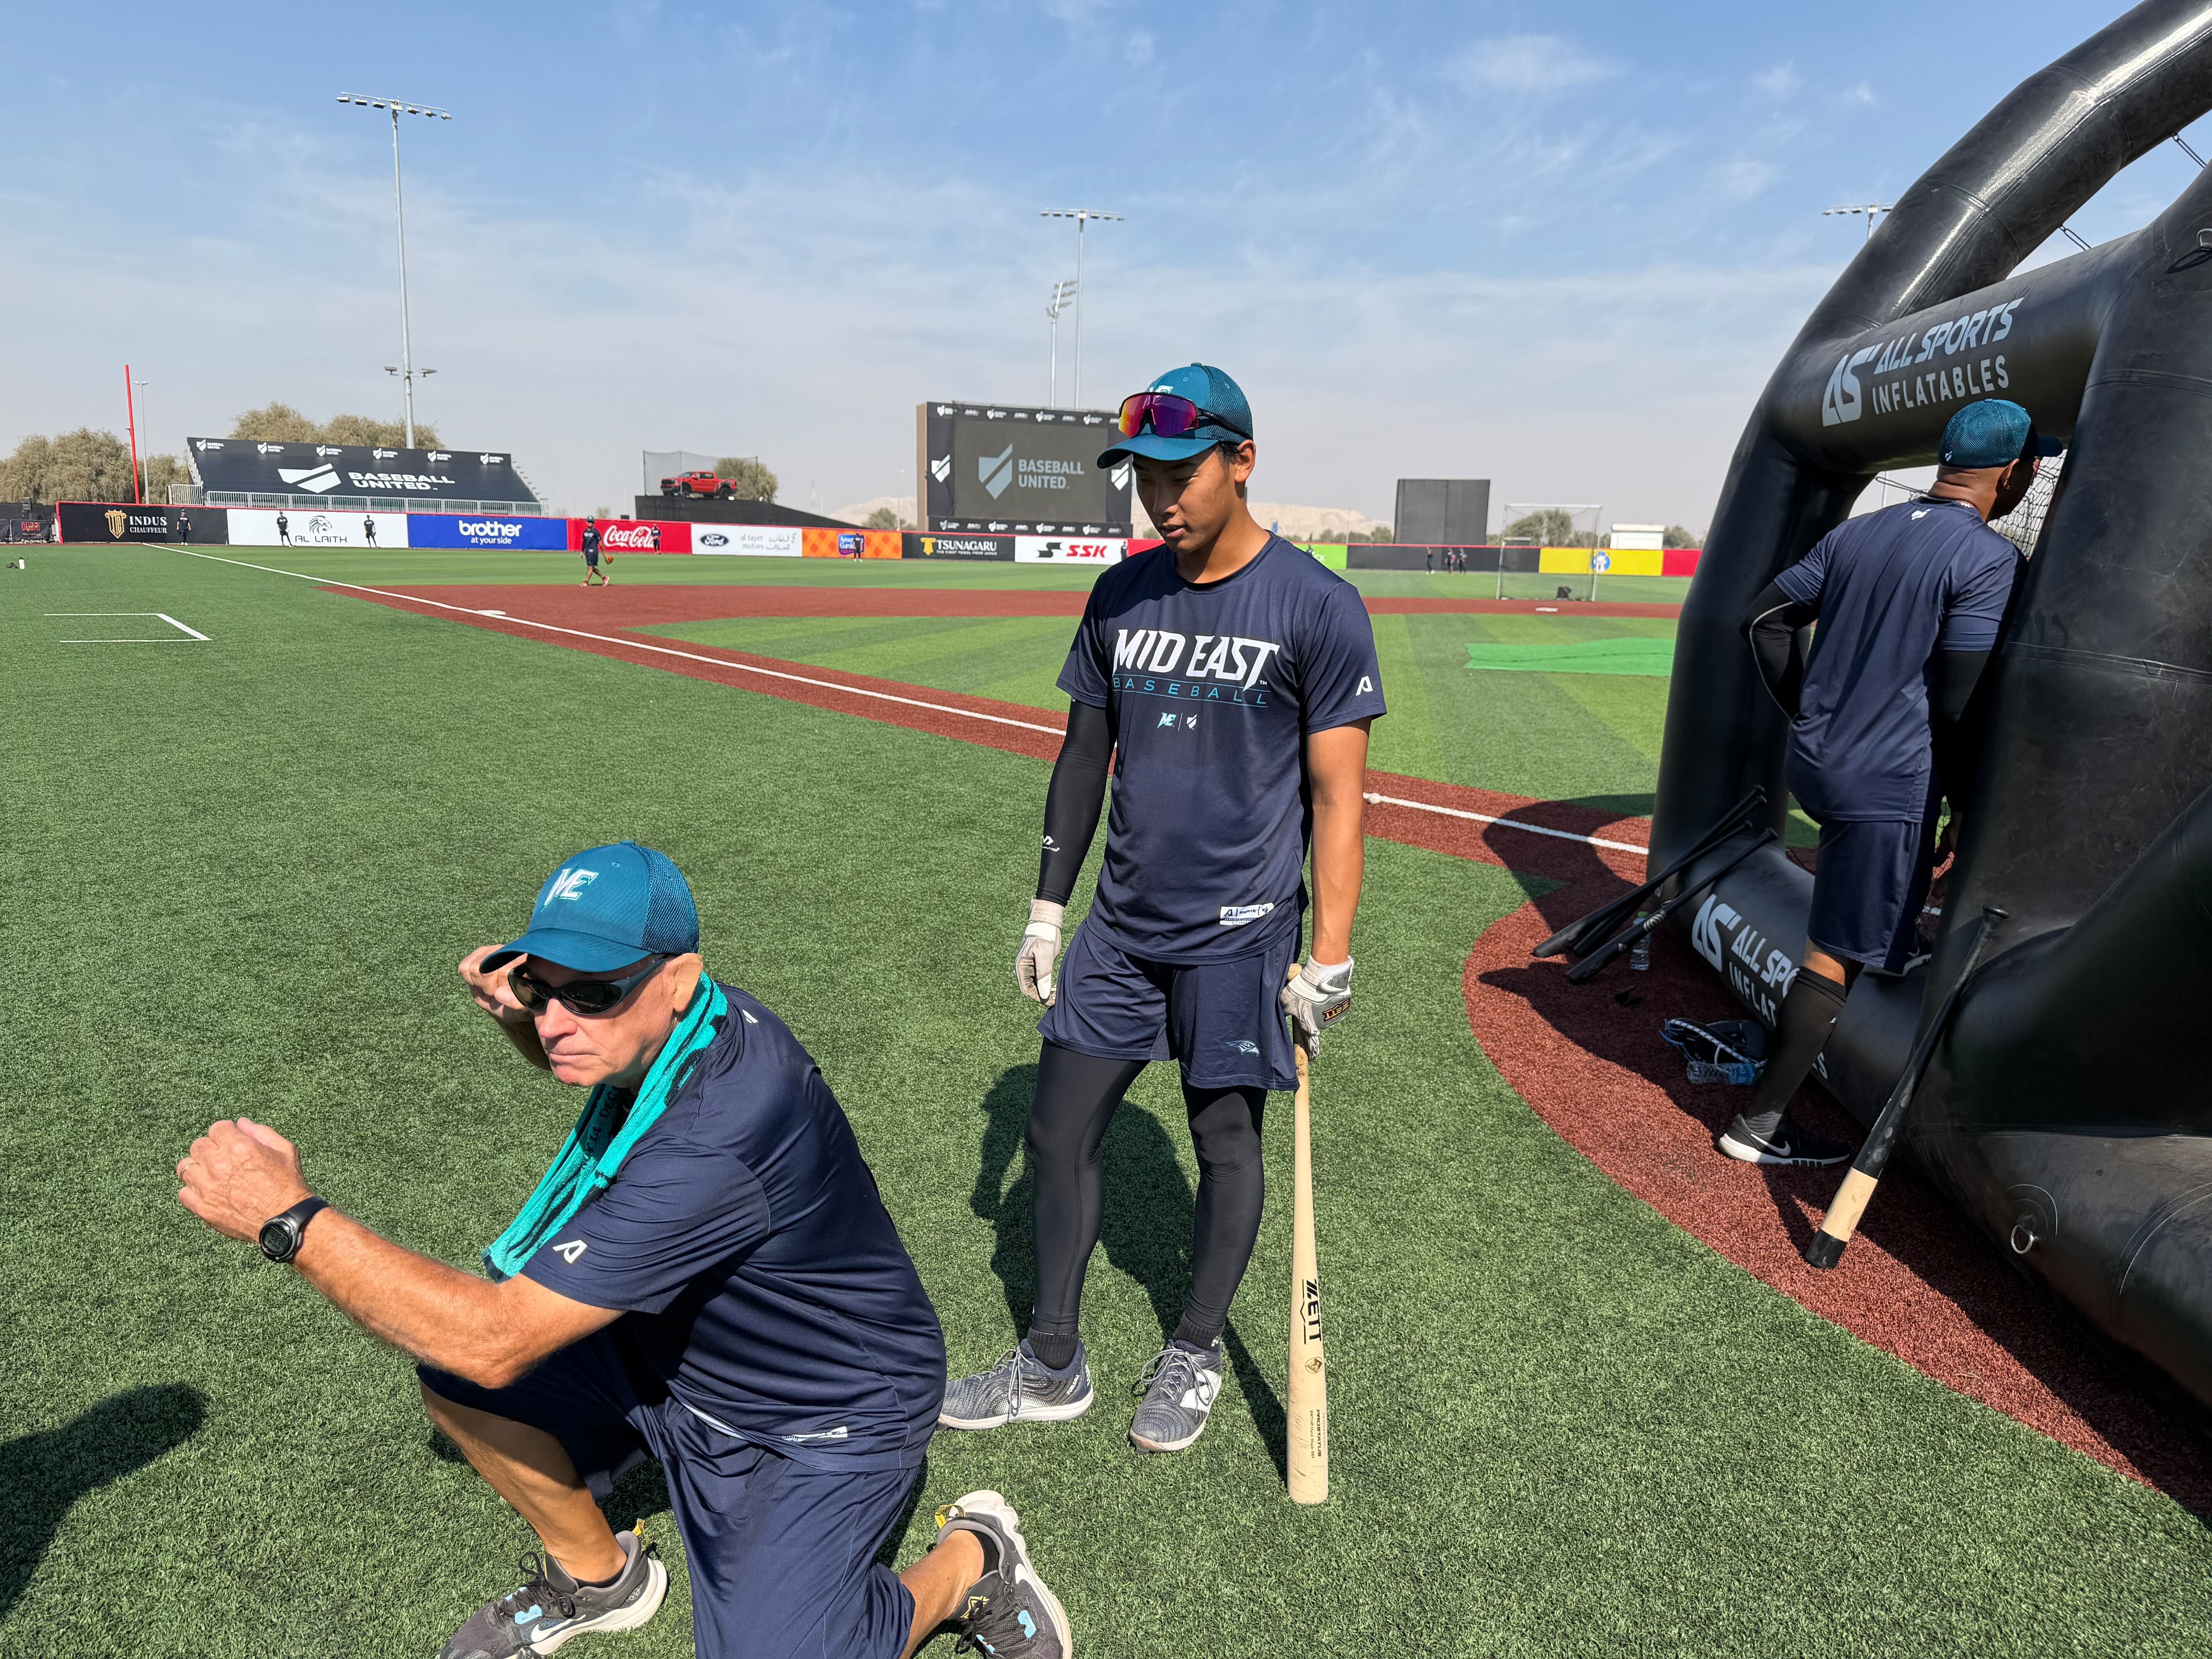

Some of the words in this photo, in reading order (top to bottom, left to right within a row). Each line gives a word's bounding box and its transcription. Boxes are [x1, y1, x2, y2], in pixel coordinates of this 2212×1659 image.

[1874, 333, 1917, 375] ALL
[1915, 297, 2024, 364] SPORTS
[1872, 355, 2009, 414] INFLATABLES
[1018, 459, 1085, 475] BASEBALL
[348, 472, 455, 484] BASEBALL
[129, 516, 167, 526] INDUS
[459, 520, 522, 537] brother
[704, 534, 725, 546] Ford
[936, 539, 997, 551] TSUNAGARU
[1066, 544, 1108, 558] SSK
[1112, 629, 1186, 678] MID
[1186, 635, 1280, 692] EAST
[1113, 677, 1266, 704] BASEBALL
[1731, 925, 1766, 973] ALL
